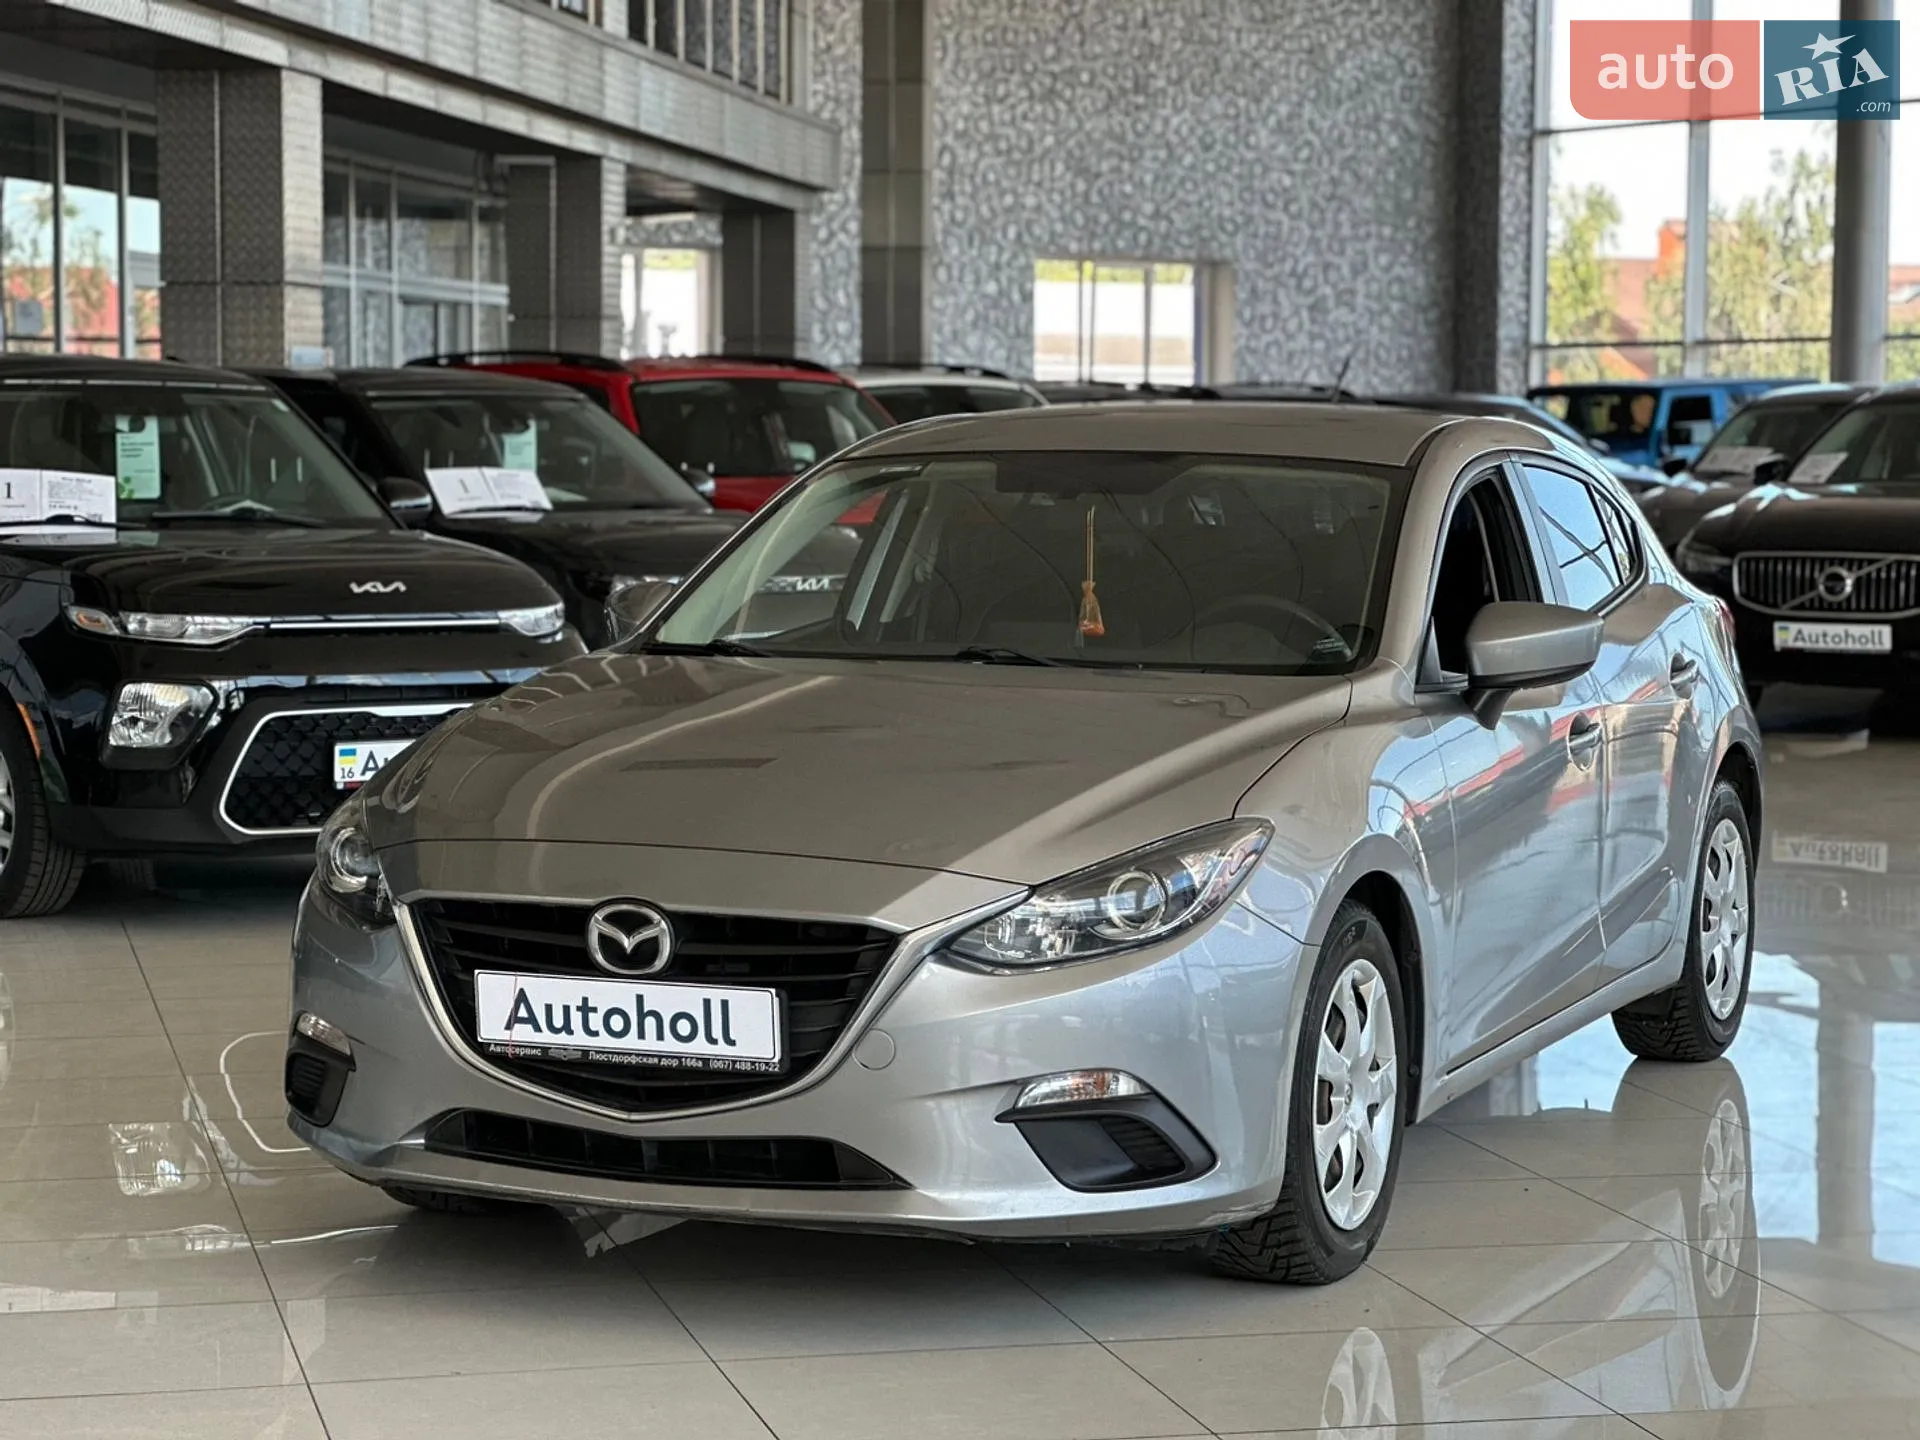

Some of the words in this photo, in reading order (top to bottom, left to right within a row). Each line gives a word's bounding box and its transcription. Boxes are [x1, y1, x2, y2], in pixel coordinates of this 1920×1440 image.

[1792, 628, 1885, 647] Autoholl
[340, 767, 355, 779] 16
[503, 987, 738, 1047] Autoholl
[588, 1051, 659, 1065] Люстдорфская
